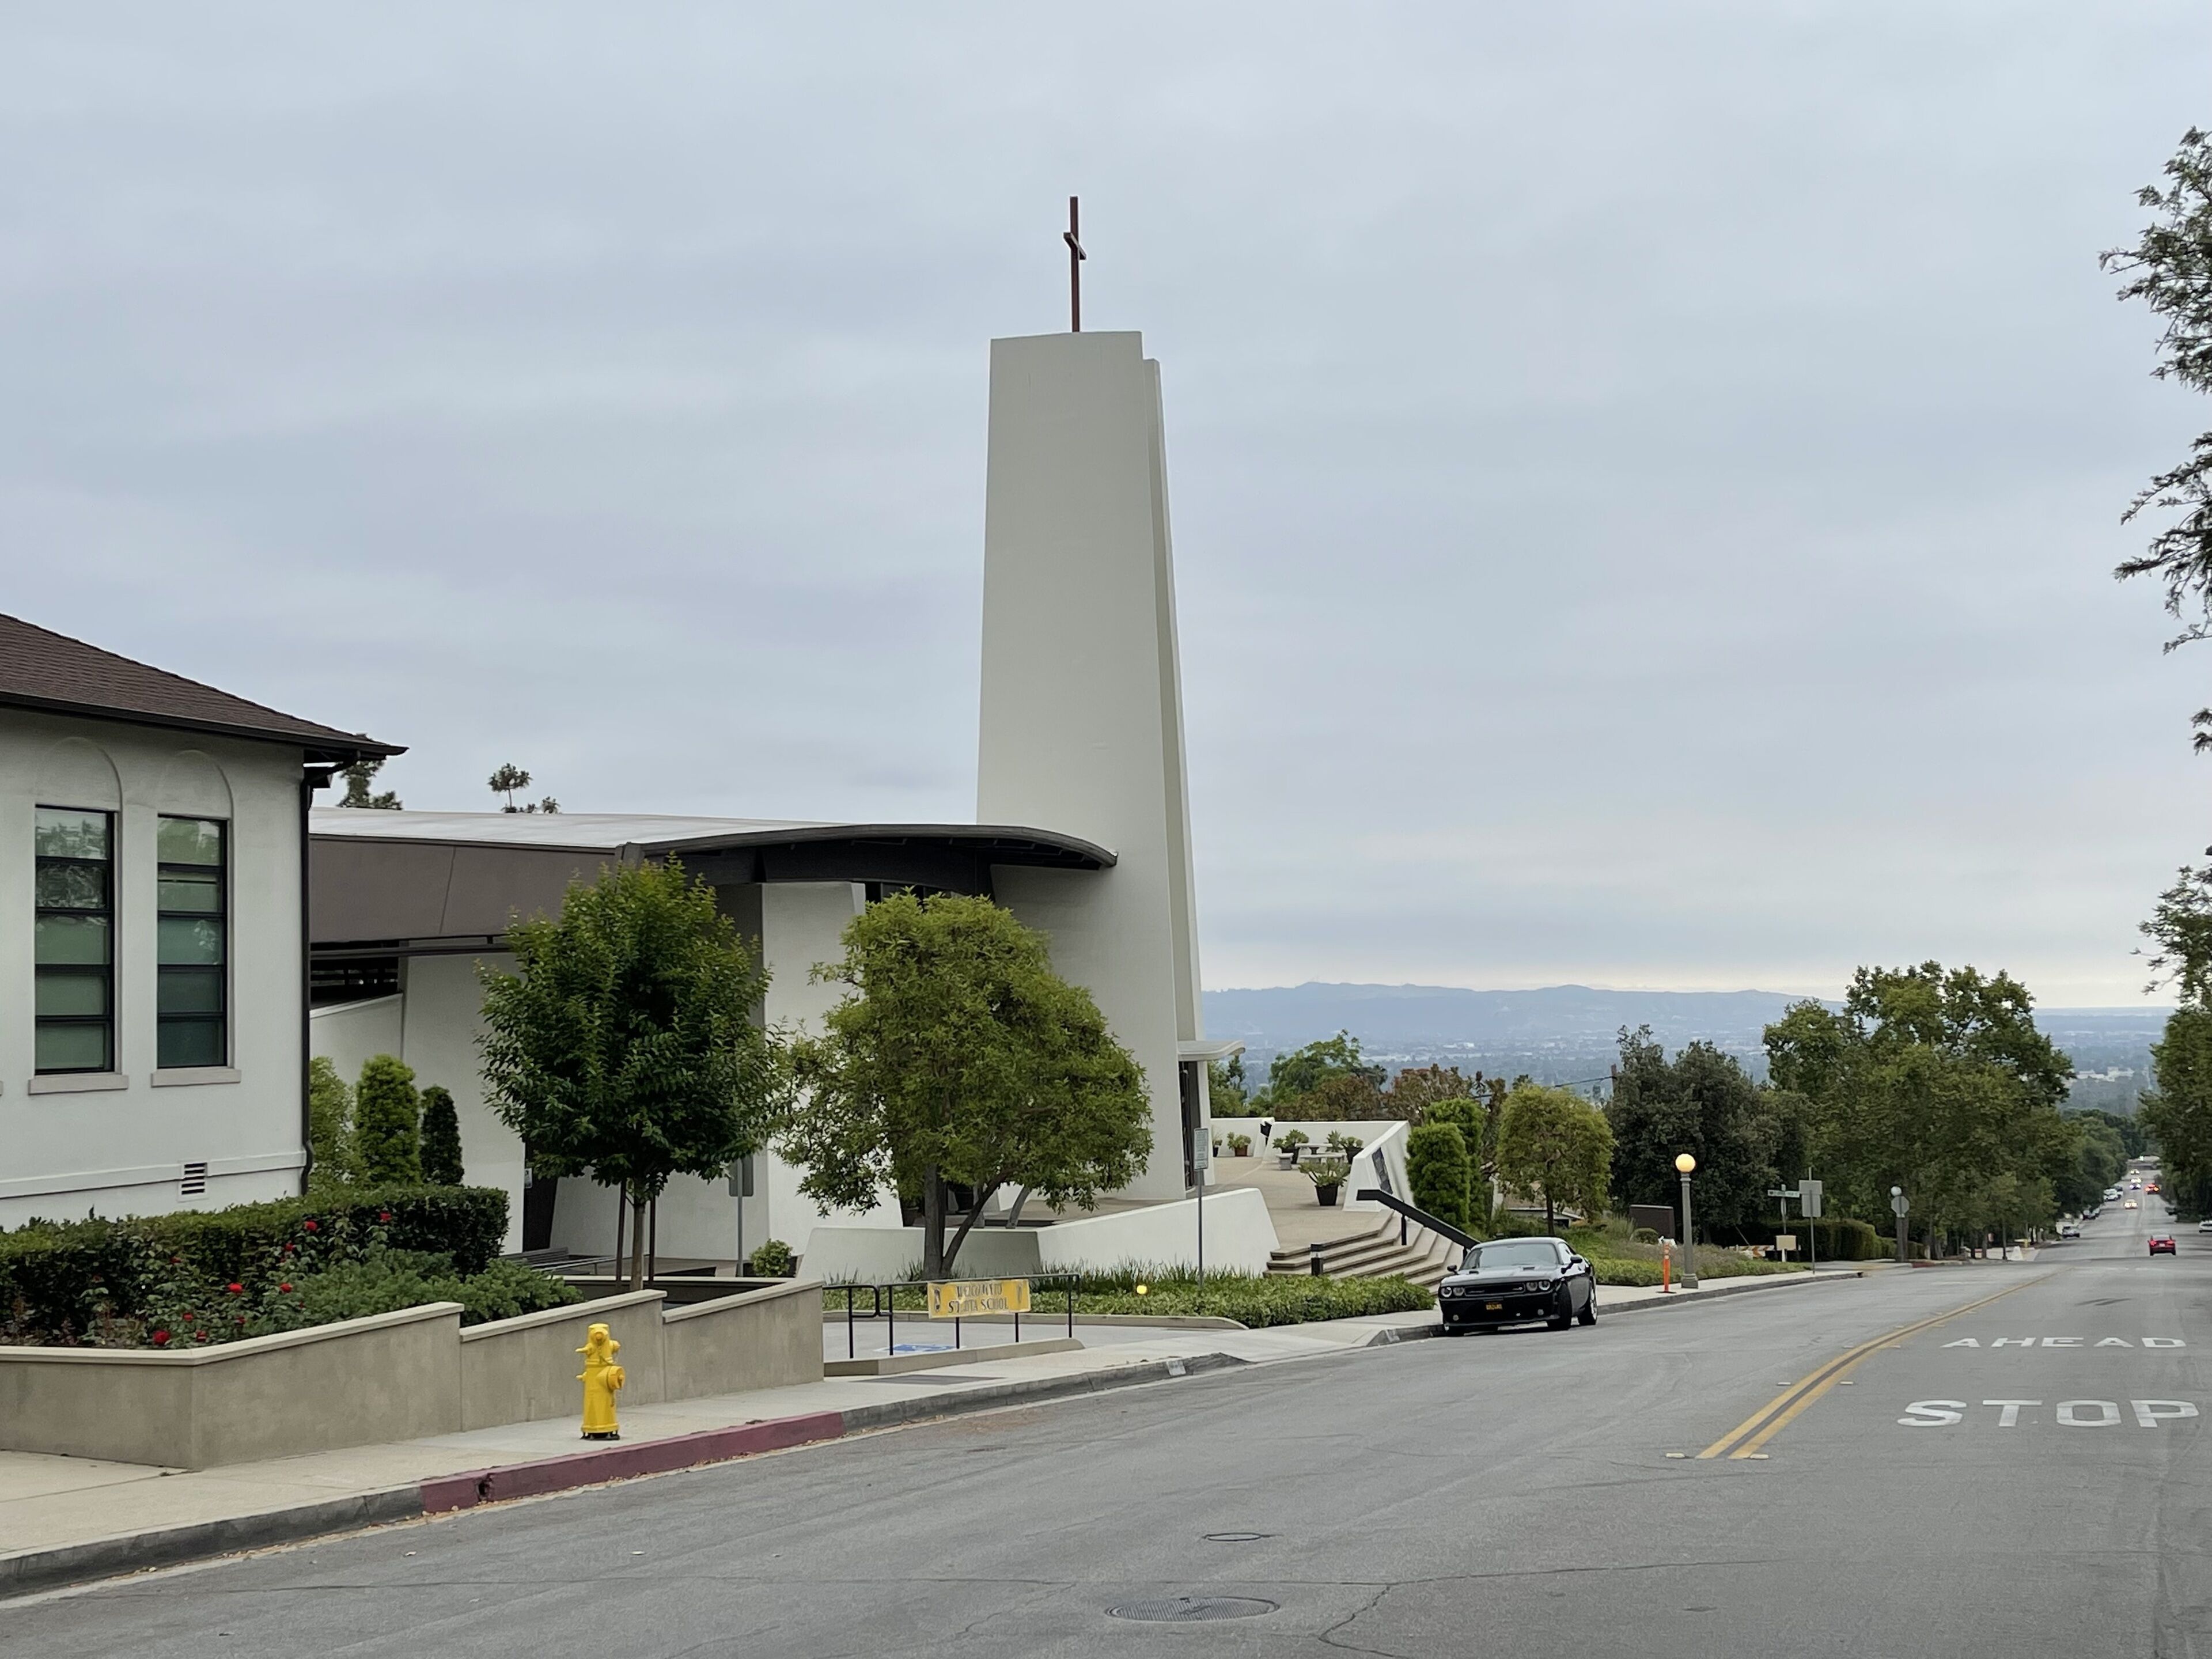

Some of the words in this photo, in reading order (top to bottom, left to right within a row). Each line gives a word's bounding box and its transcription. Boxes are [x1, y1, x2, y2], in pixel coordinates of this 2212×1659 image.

[980, 1297, 1009, 1310] SCHOOL
[1940, 1337, 2187, 1348] AHEAD
[1897, 1399, 2200, 1428] STOP
